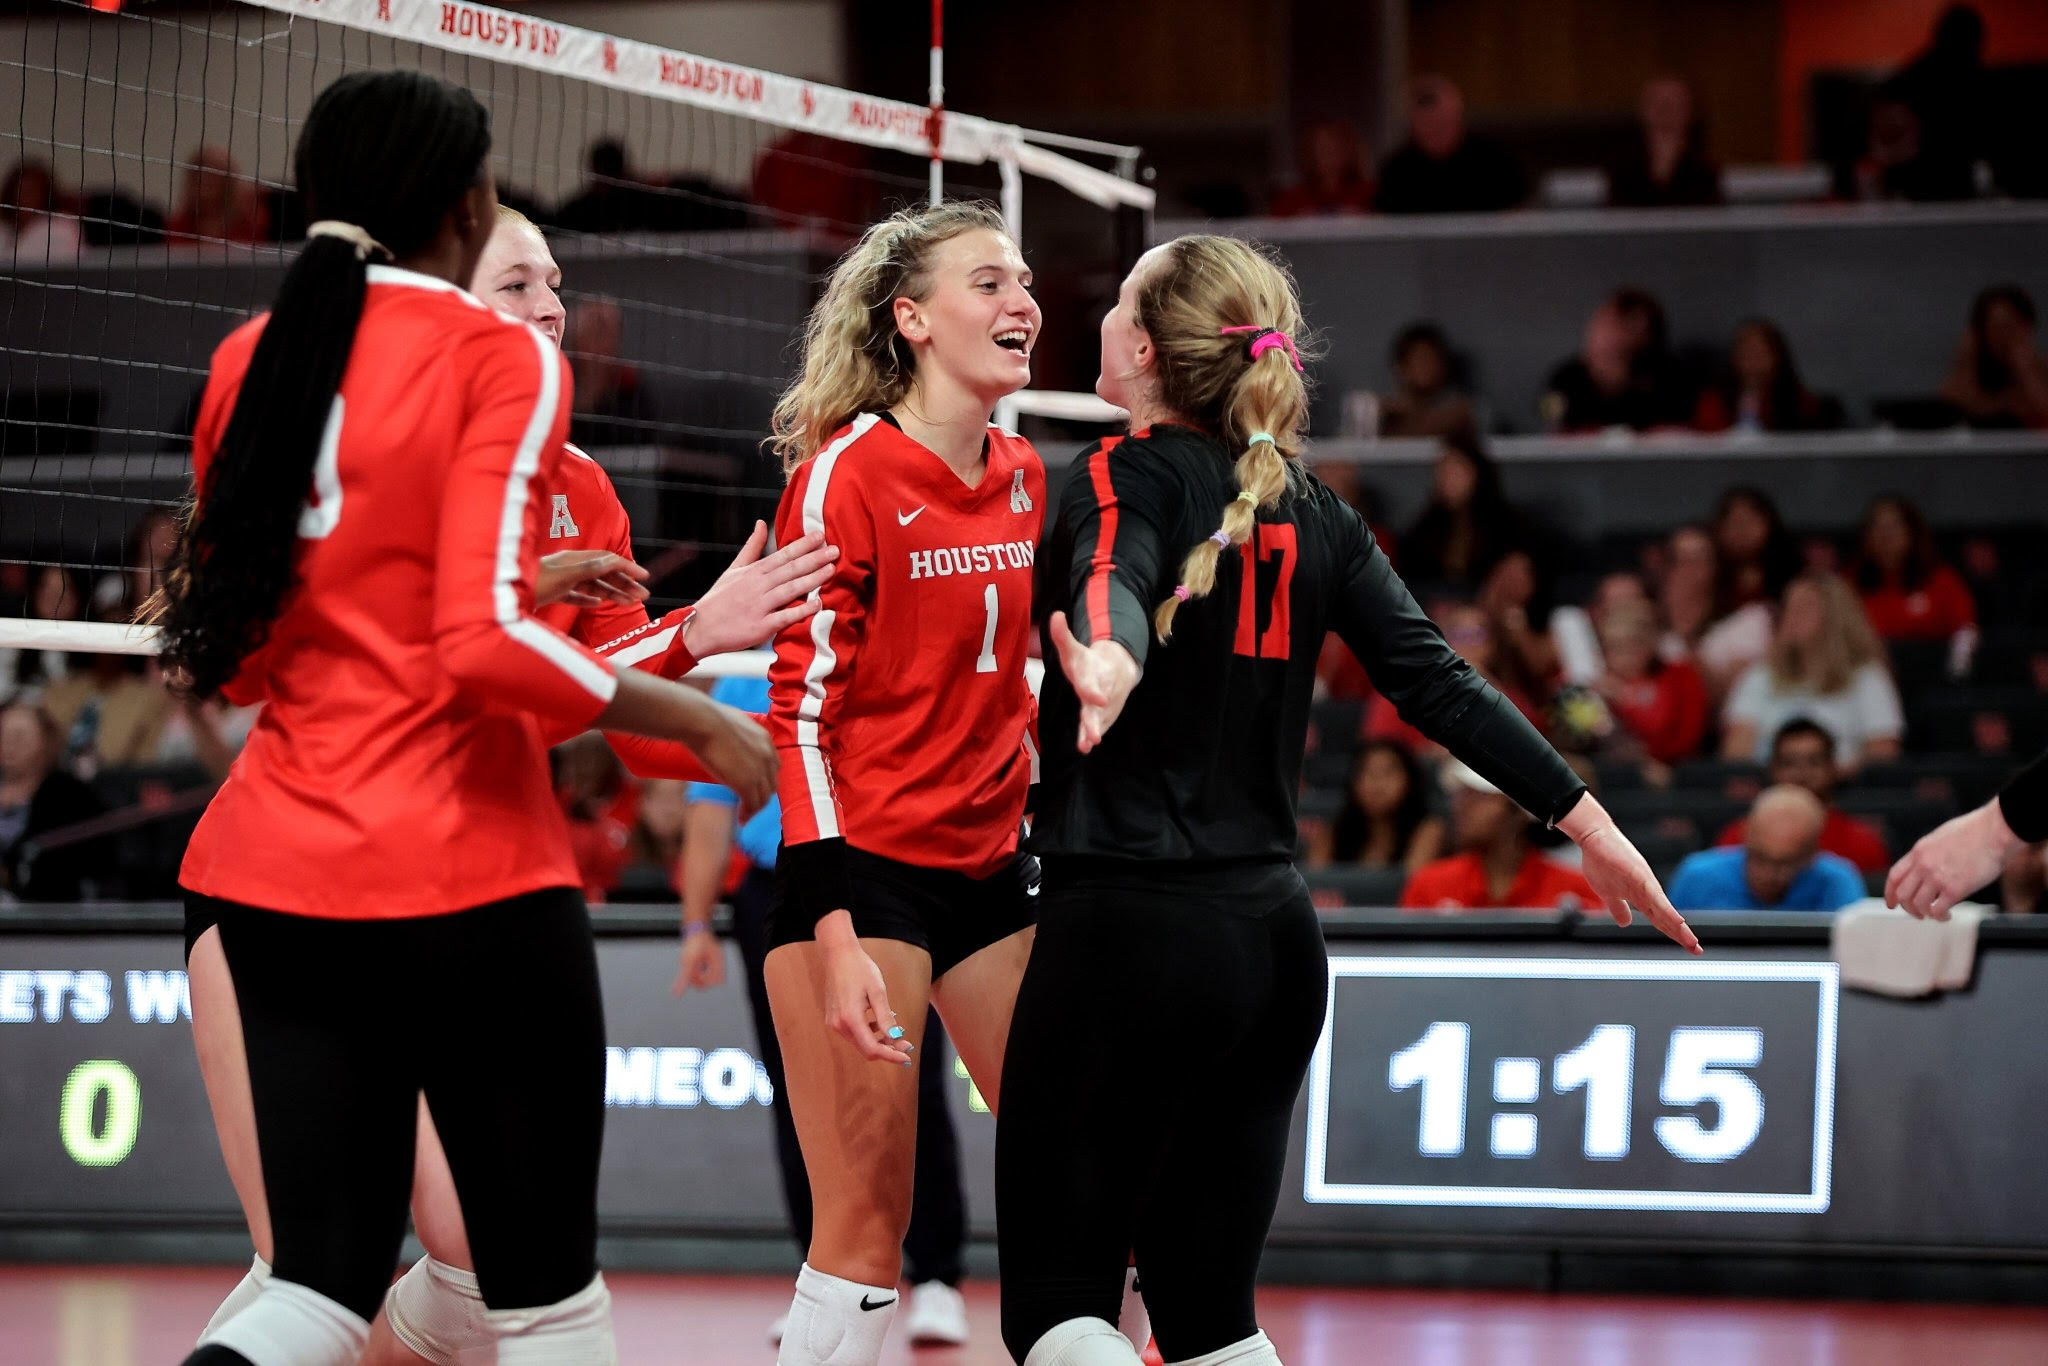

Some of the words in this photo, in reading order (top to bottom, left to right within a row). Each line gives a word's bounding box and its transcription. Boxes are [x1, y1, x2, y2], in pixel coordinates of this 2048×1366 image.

[441, 4, 560, 56] HOUSTON
[659, 54, 763, 102] HOUSTON
[549, 494, 580, 539] A
[909, 539, 1035, 580] HOUSTON
[976, 583, 999, 673] 1
[1233, 522, 1298, 661] 17
[60, 1059, 142, 1167] 0
[1388, 1021, 1766, 1163] 1:15
